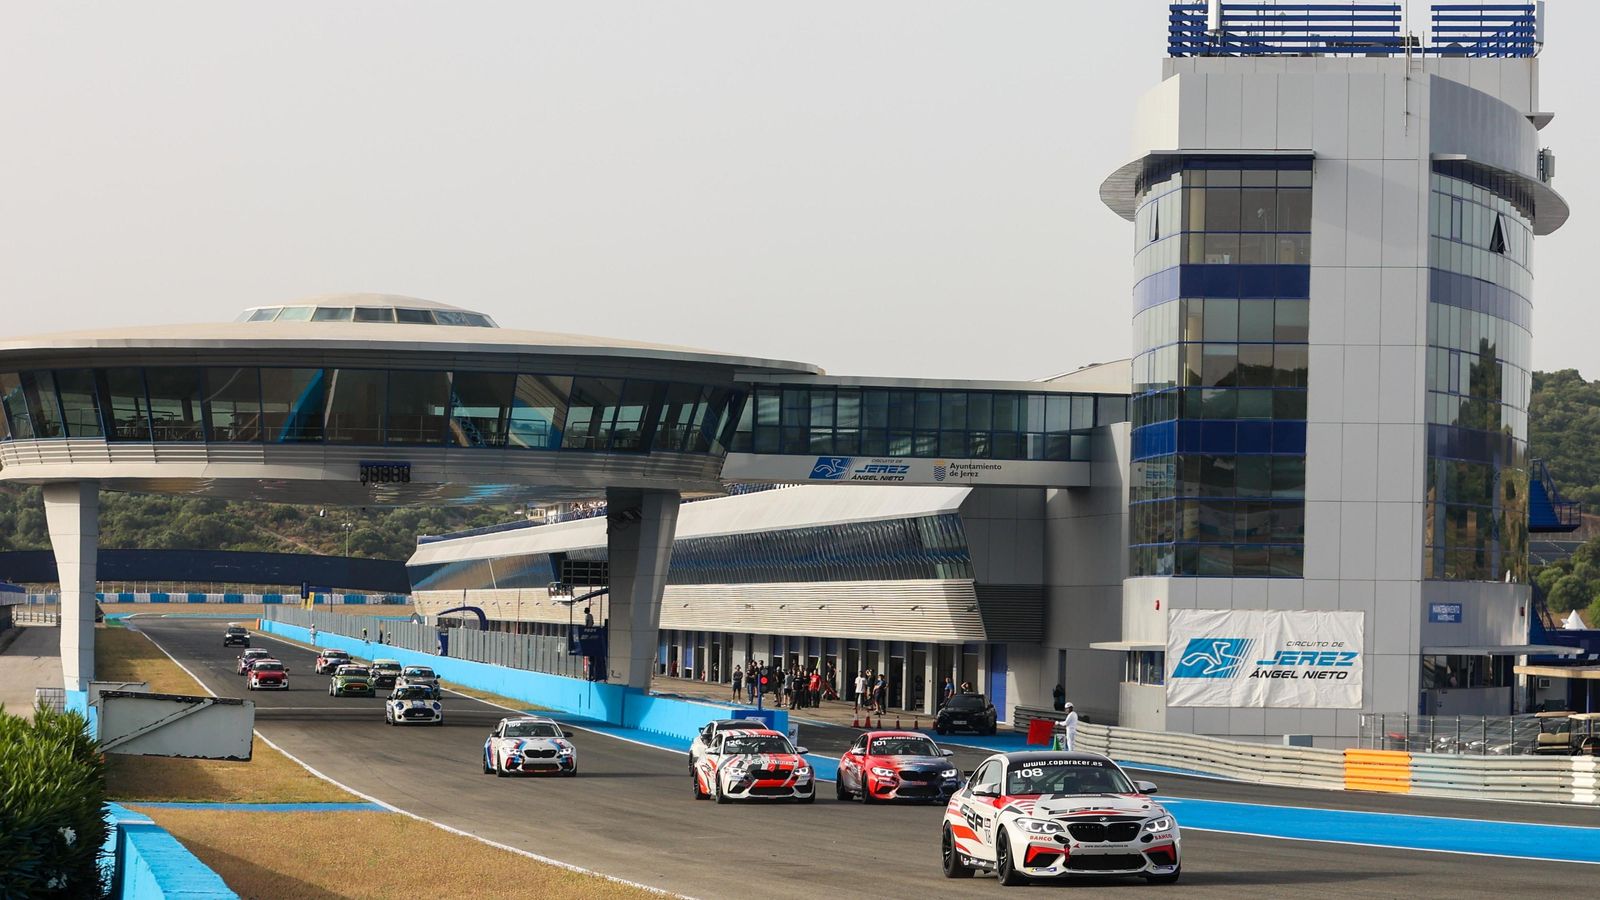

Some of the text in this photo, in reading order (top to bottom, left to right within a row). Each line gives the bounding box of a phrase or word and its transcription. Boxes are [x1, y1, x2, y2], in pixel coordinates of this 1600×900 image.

[854, 464, 911, 474] JEREZ
[949, 462, 1002, 472] Ayuntamiento
[851, 473, 878, 481] ÁNGEL
[959, 470, 979, 478] Jerez
[1286, 640, 1329, 648] CIRCUITO
[1256, 650, 1360, 667] JEREZ
[1249, 667, 1348, 680] ÁNGEL NIETO
[1023, 759, 1103, 768] www.coparacer.es
[1014, 768, 1044, 779] 108
